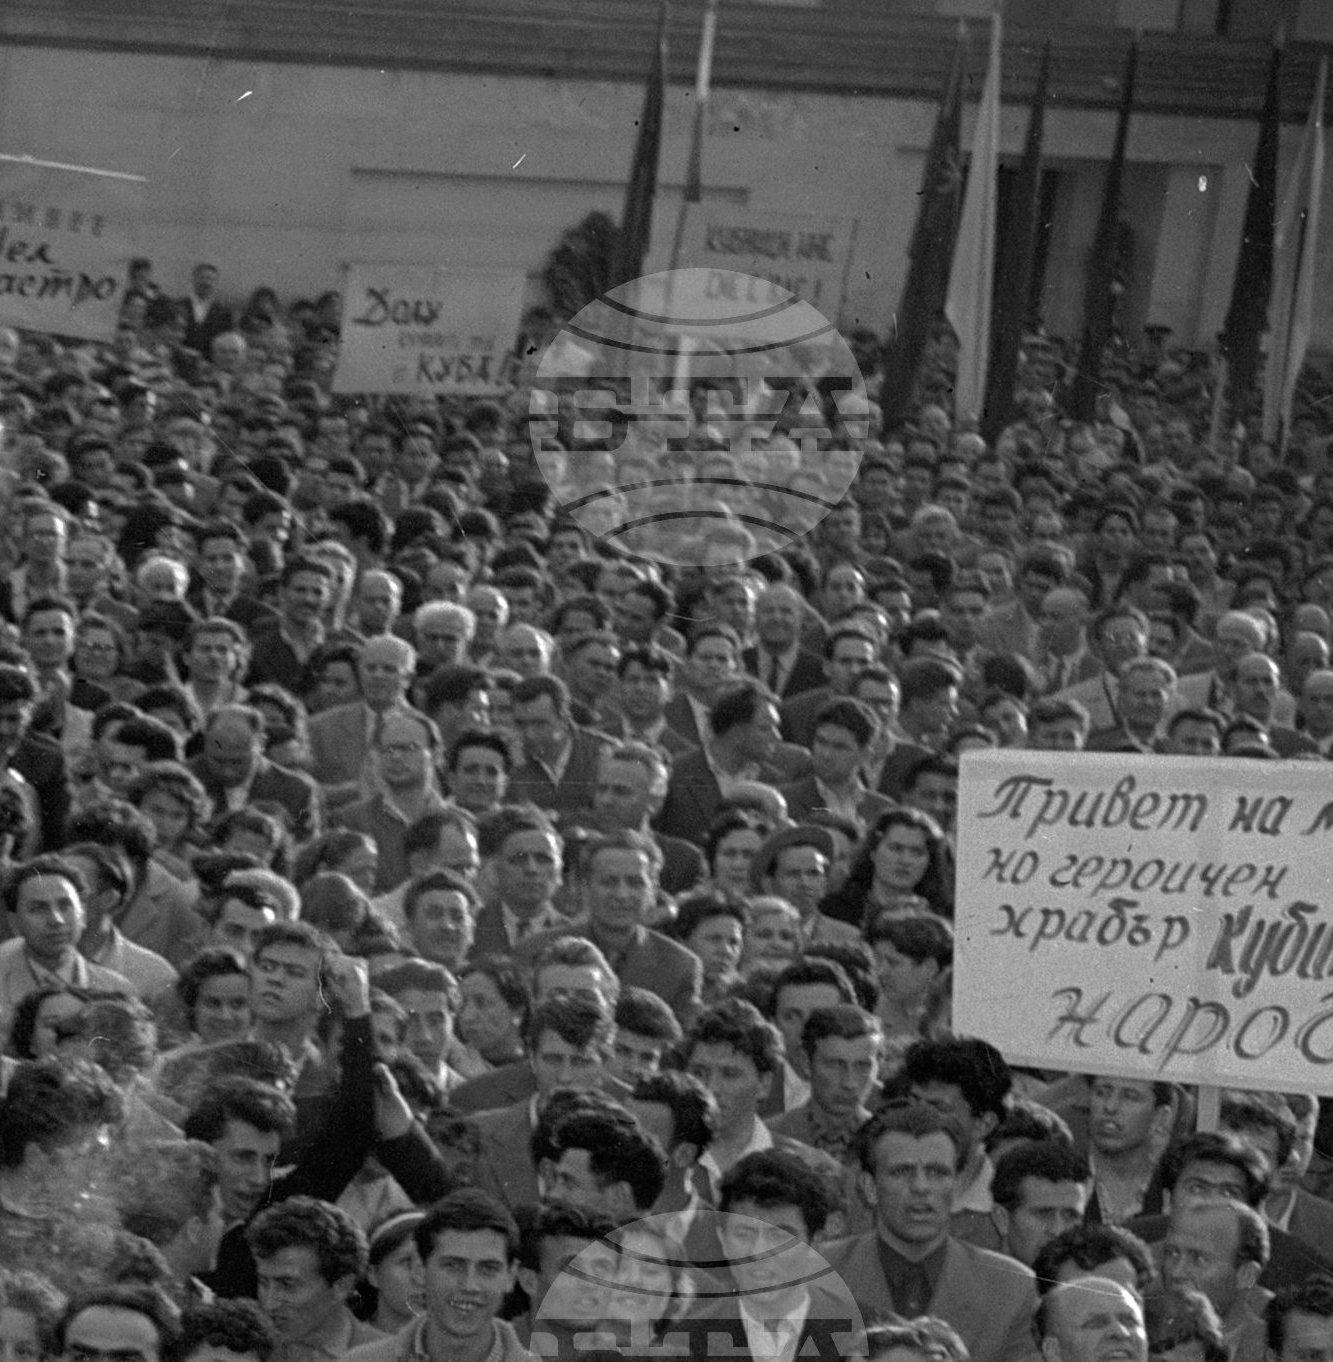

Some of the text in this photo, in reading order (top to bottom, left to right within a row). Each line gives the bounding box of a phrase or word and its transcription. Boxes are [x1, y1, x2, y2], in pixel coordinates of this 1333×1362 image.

[976, 773, 1208, 840] Привет
[1228, 794, 1295, 837] на
[982, 846, 1290, 900] но героичен
[990, 896, 1191, 962] храбър
